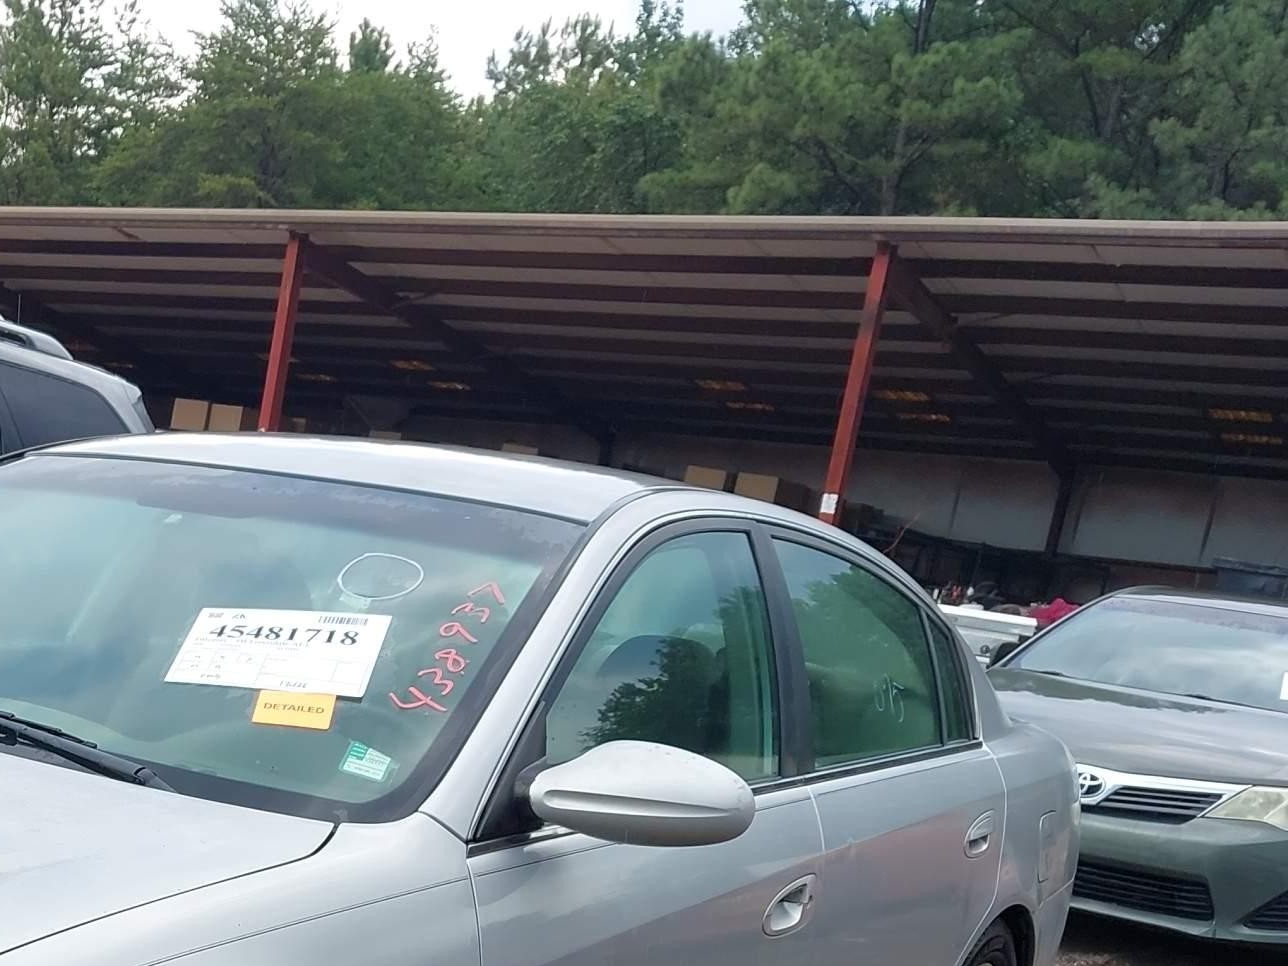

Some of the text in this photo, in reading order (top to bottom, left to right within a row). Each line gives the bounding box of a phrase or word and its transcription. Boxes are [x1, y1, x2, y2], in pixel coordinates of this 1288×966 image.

[209, 624, 360, 646] 45481718
[389, 581, 505, 712] 438937
[263, 702, 325, 715] DETAILED
